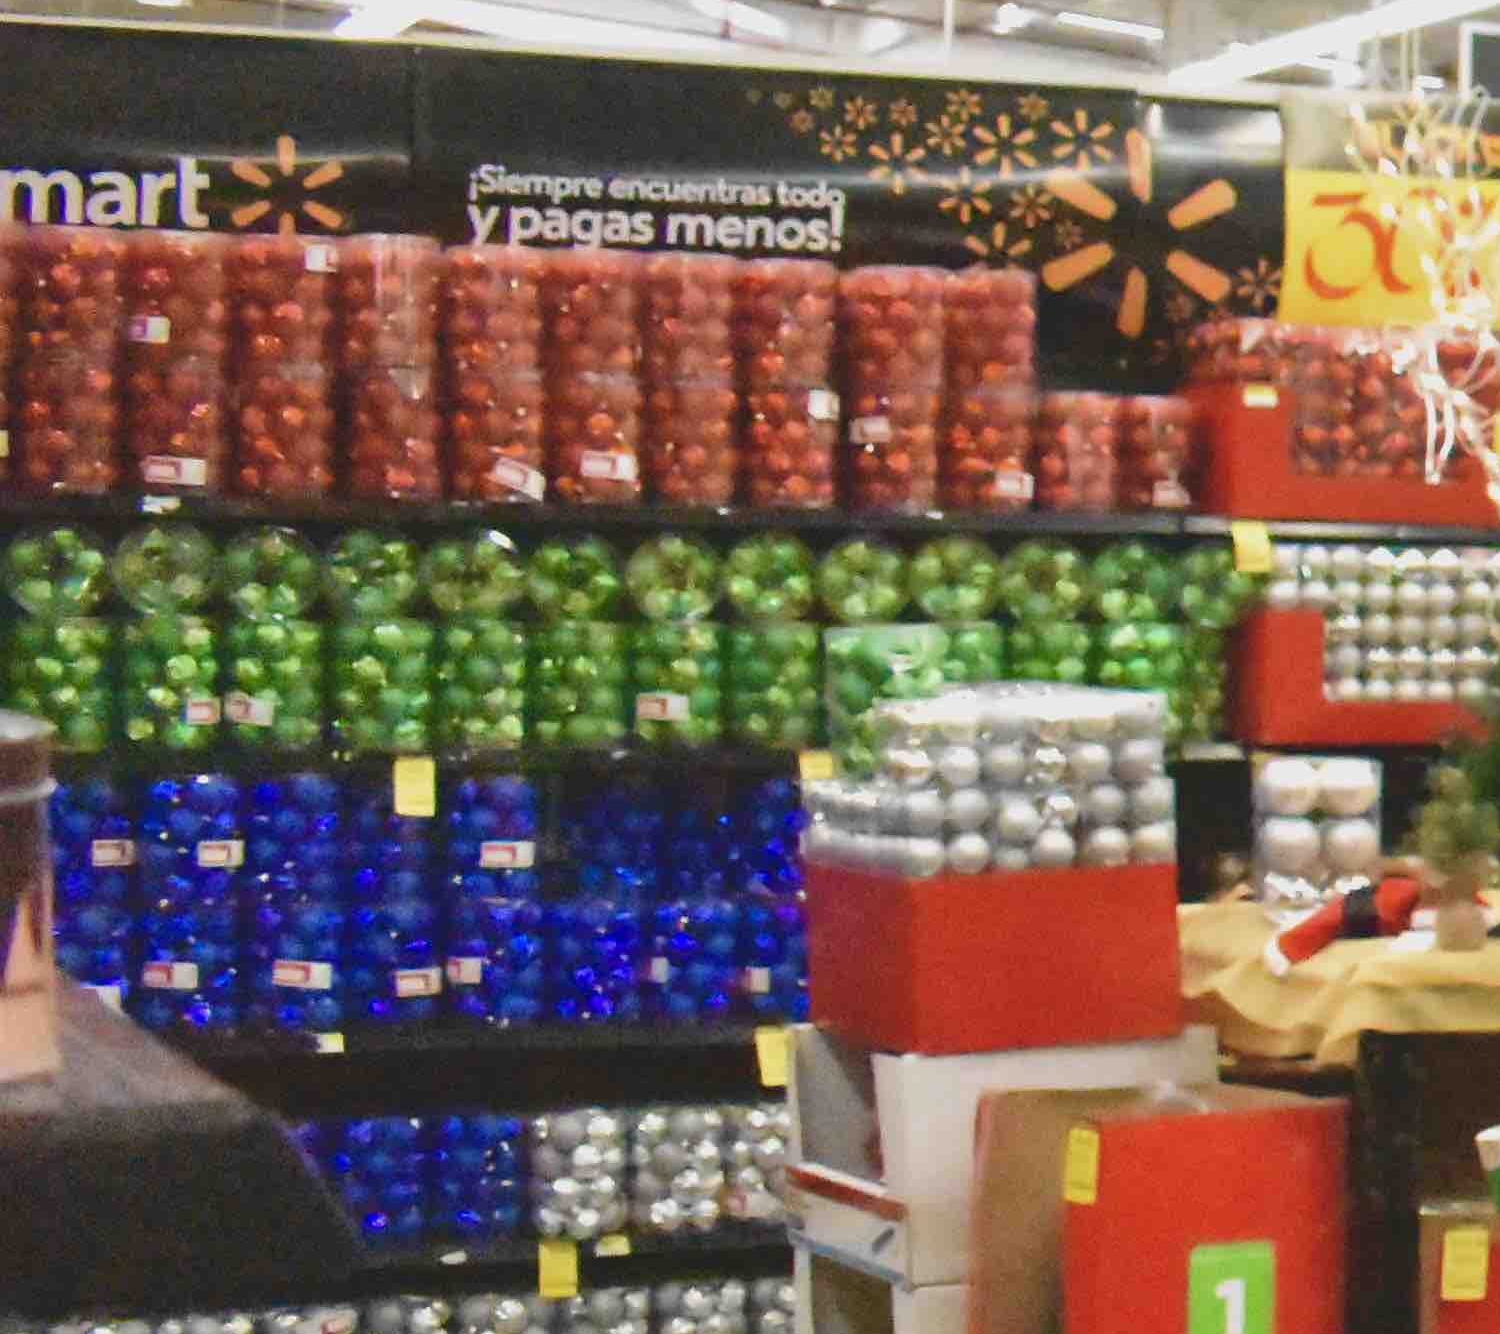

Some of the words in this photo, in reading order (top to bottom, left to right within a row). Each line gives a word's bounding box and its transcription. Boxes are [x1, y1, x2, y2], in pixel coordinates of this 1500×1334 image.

[0, 153, 211, 228] mart
[468, 163, 602, 205] ¡Siempre
[608, 175, 770, 207] encuentras
[776, 178, 844, 210] todo
[468, 204, 499, 246] y
[508, 204, 655, 249] pagas
[665, 198, 845, 252] menos!
